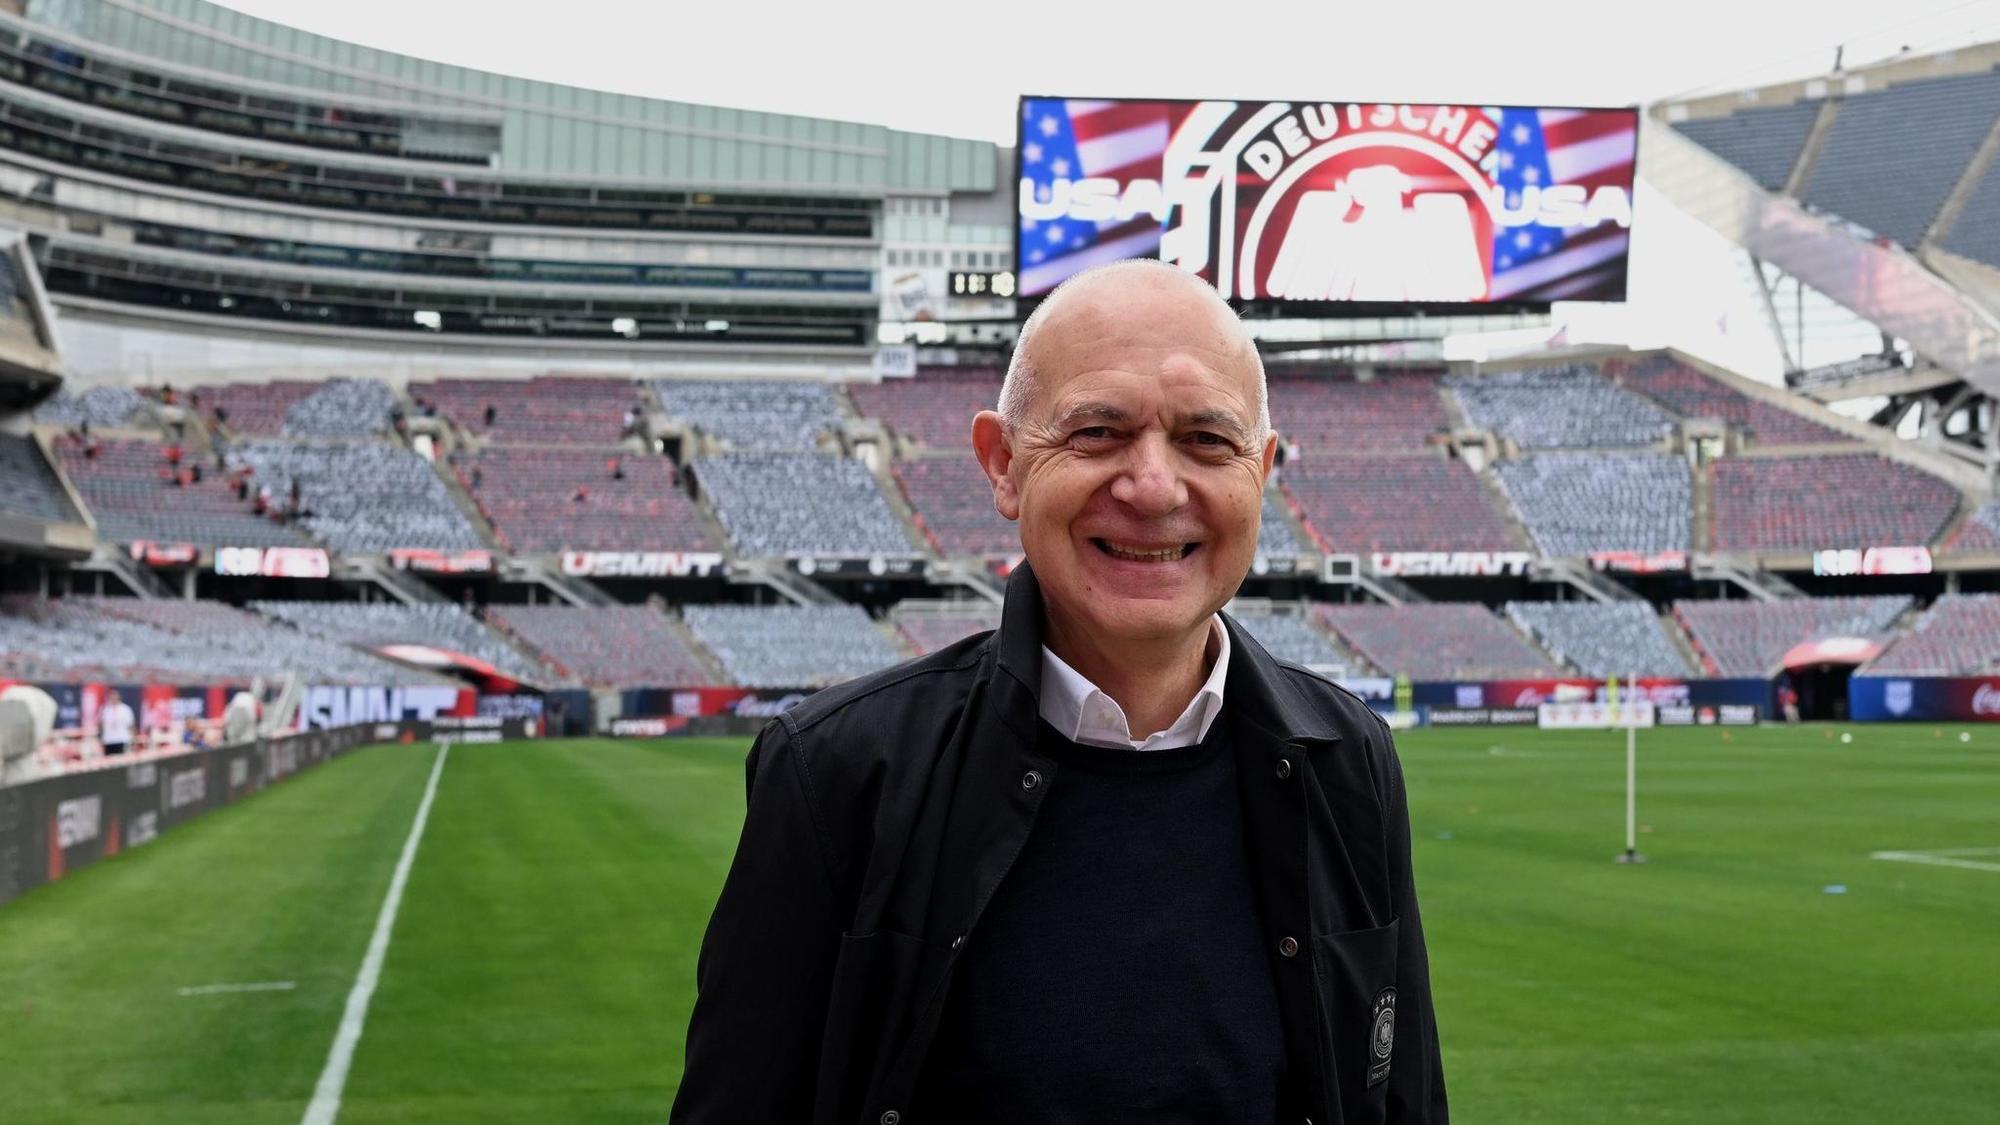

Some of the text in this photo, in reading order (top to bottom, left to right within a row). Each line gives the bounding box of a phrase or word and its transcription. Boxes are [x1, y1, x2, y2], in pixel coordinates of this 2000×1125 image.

[1018, 178, 1162, 223] USA
[1492, 185, 1632, 229] USA
[563, 552, 723, 577] USMNT
[1373, 552, 1531, 577] USMNT
